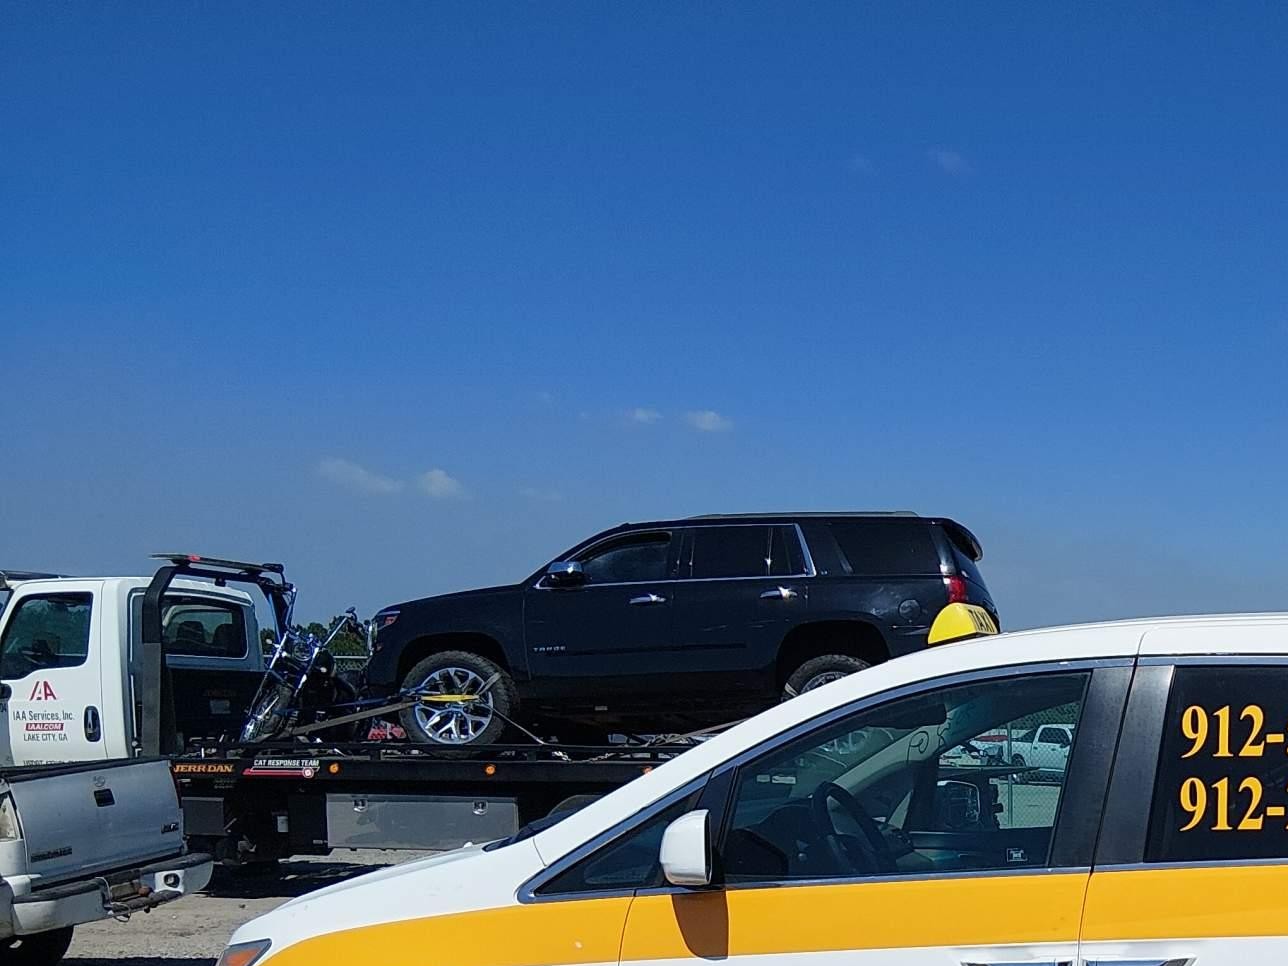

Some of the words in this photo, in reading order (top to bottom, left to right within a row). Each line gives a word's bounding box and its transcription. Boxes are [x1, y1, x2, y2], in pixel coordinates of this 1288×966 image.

[12, 711, 27, 721] IAA
[28, 710, 62, 722] Services,
[23, 734, 40, 742] LAKE
[173, 764, 206, 773] JERR
[207, 764, 233, 773] DAN
